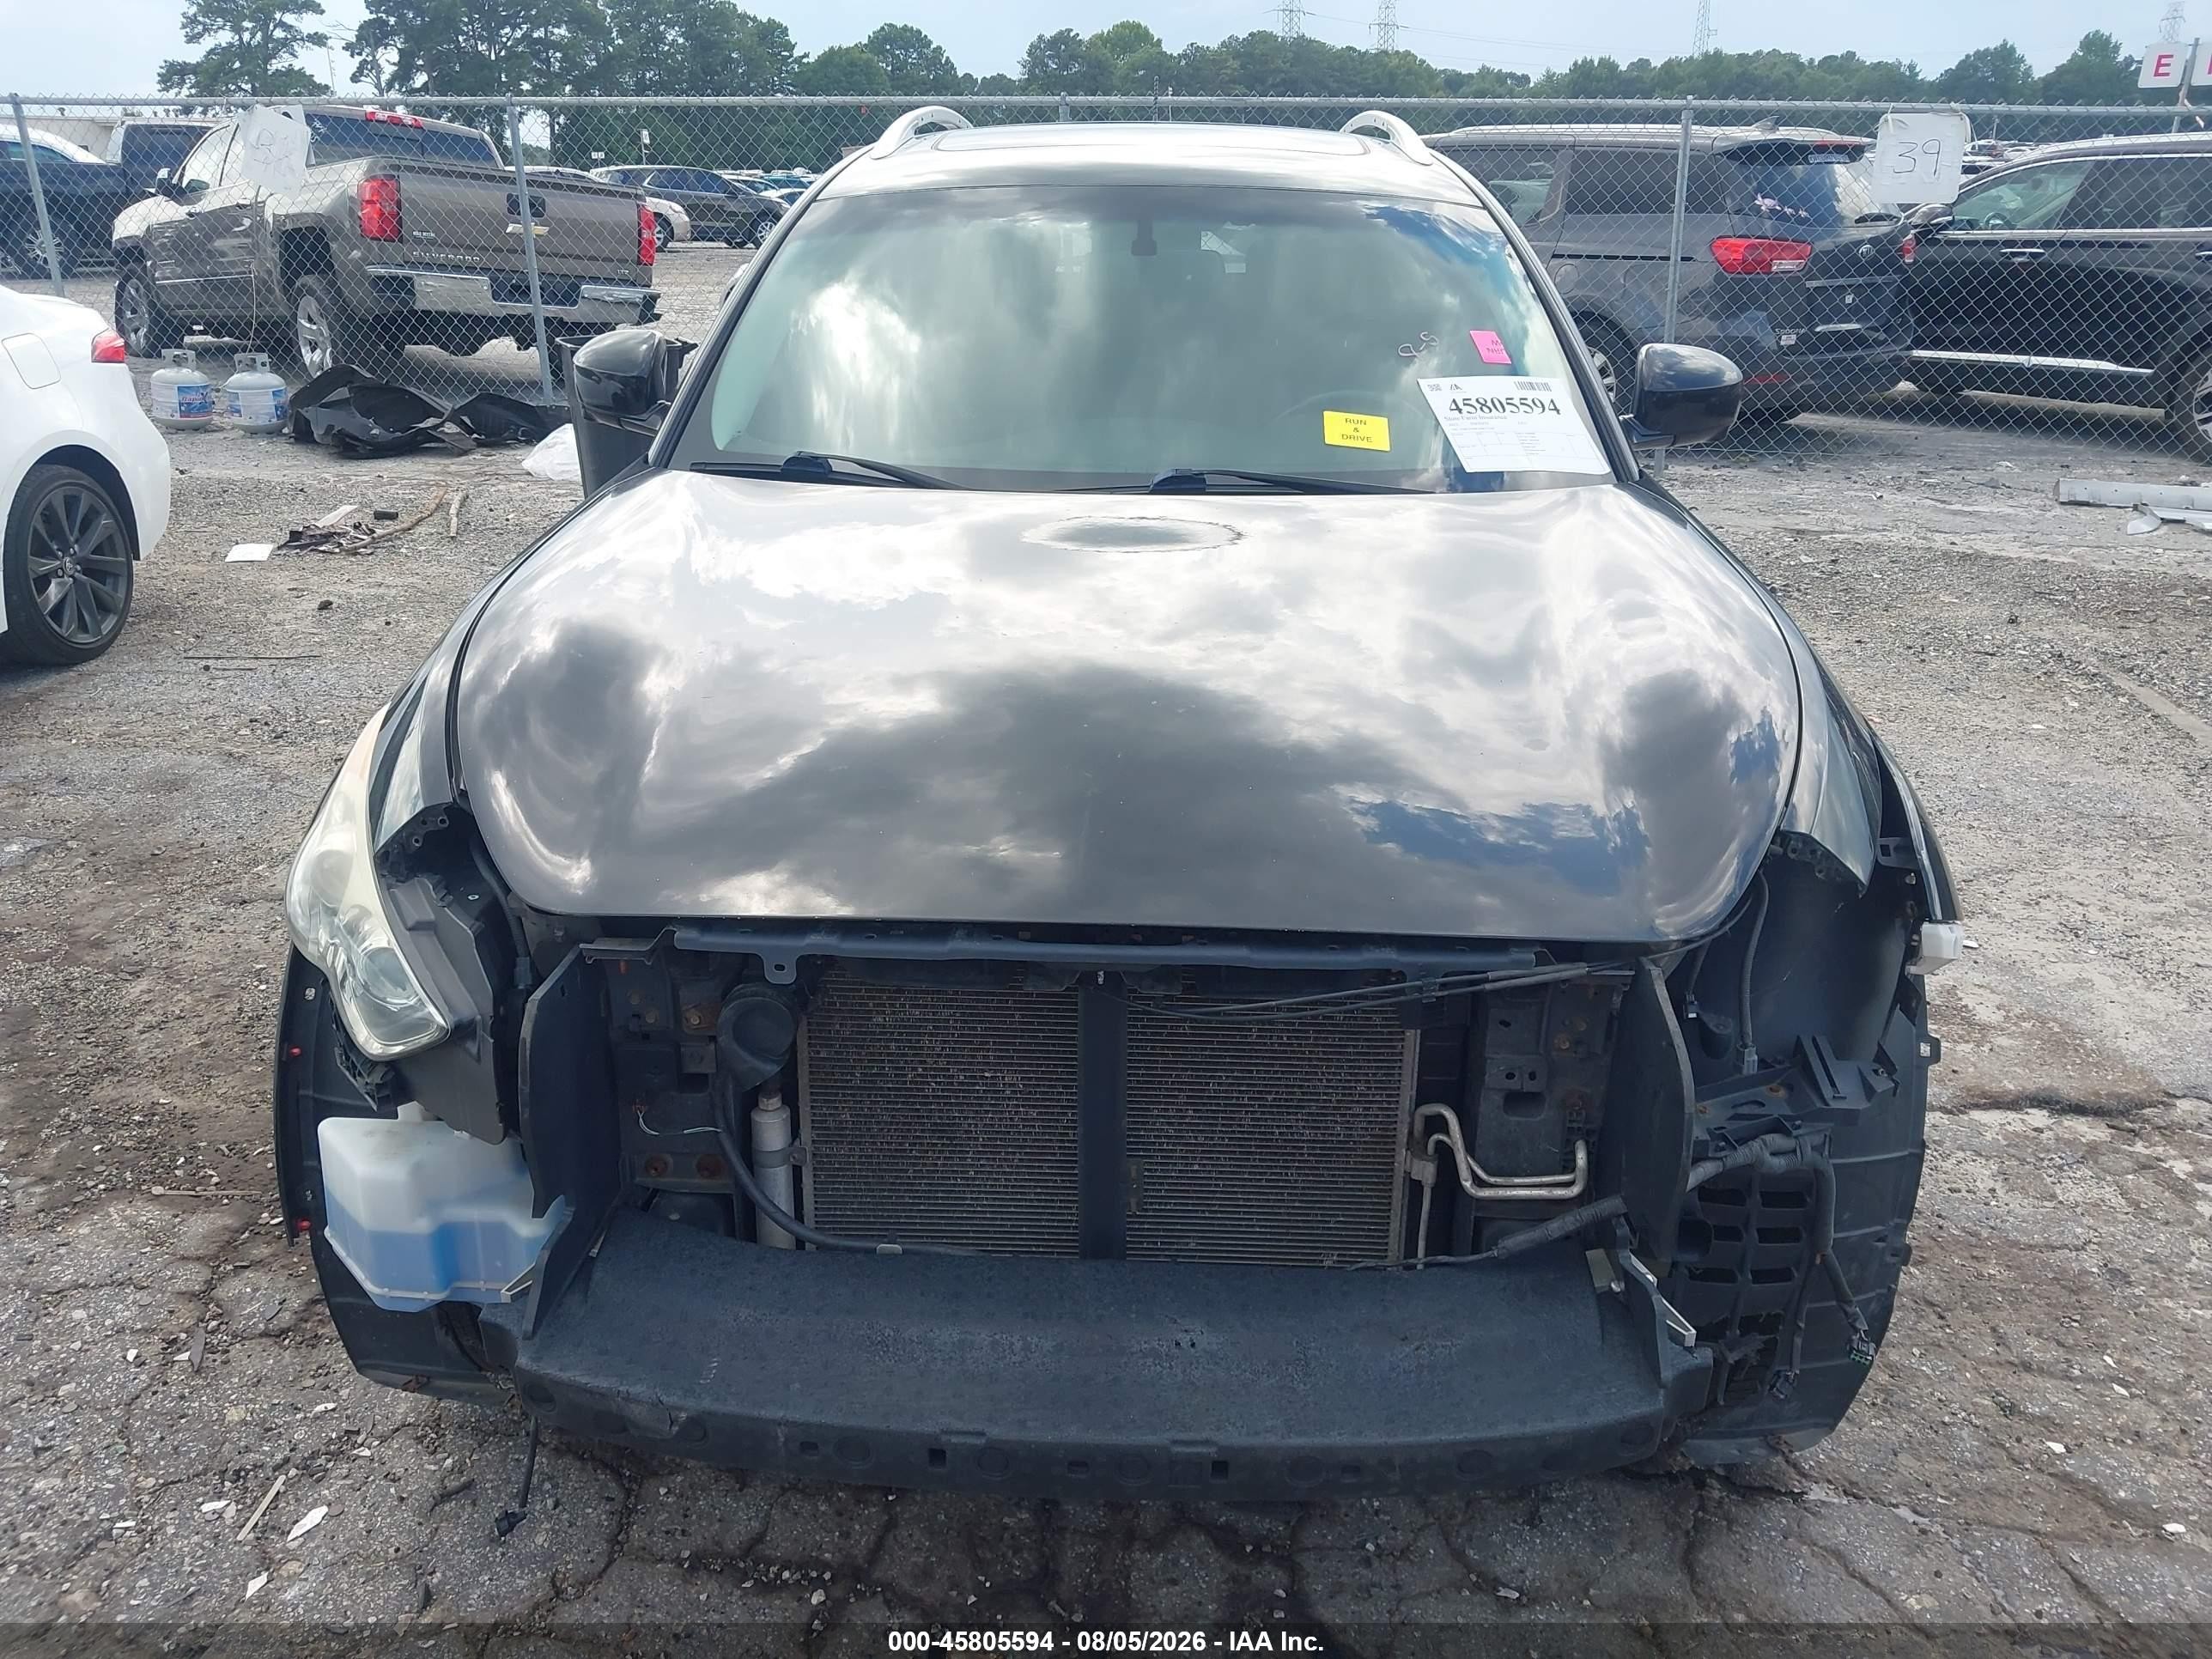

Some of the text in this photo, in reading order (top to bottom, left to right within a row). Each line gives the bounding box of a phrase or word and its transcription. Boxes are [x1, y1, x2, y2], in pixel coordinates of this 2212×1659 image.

[2154, 54, 2174, 77] E
[1893, 138, 1941, 178] 39
[1449, 397, 1562, 416] 45805594
[1345, 417, 1368, 426] RUN
[1341, 434, 1374, 443] DRIVE
